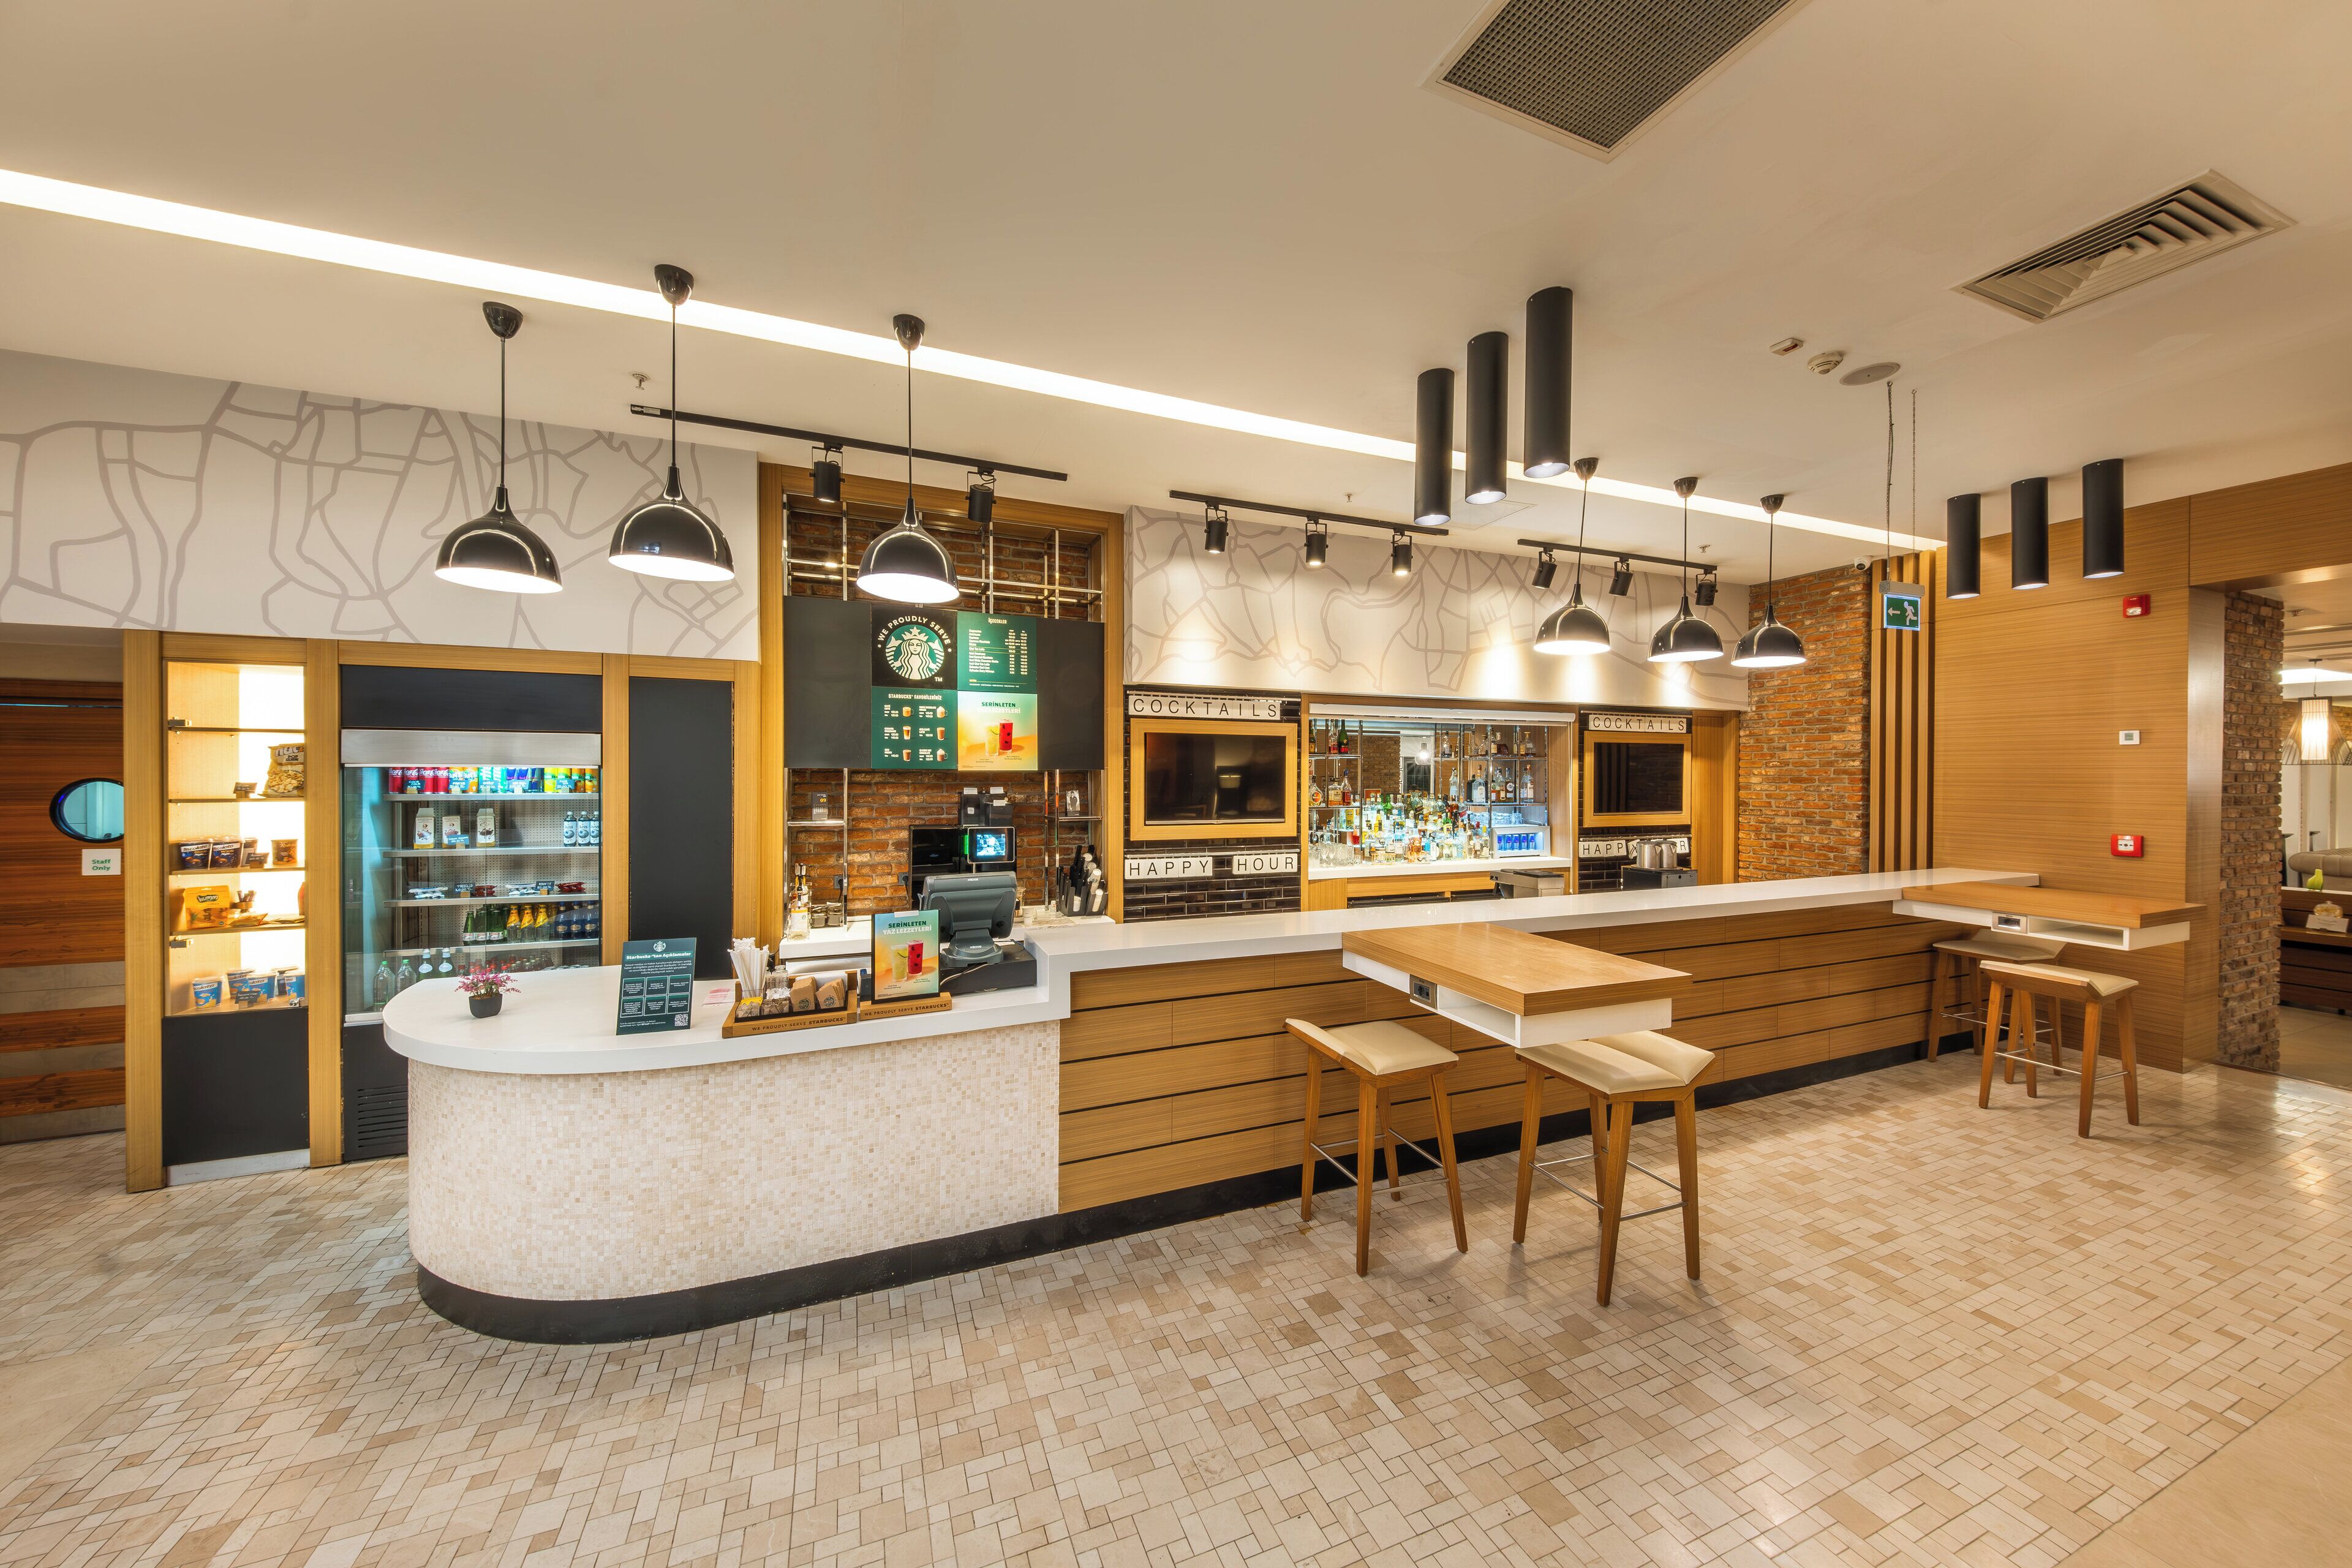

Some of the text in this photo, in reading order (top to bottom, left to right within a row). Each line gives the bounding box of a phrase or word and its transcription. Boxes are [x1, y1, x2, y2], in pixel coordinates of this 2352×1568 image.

[878, 616, 951, 644] WE PROUDLY SERVE
[1133, 698, 1277, 718] COCKTAILS
[1593, 717, 1685, 731] COCKTAILS
[1129, 856, 1294, 876] HAPPY HOUR
[896, 925, 932, 934] LEZZETLERİ
